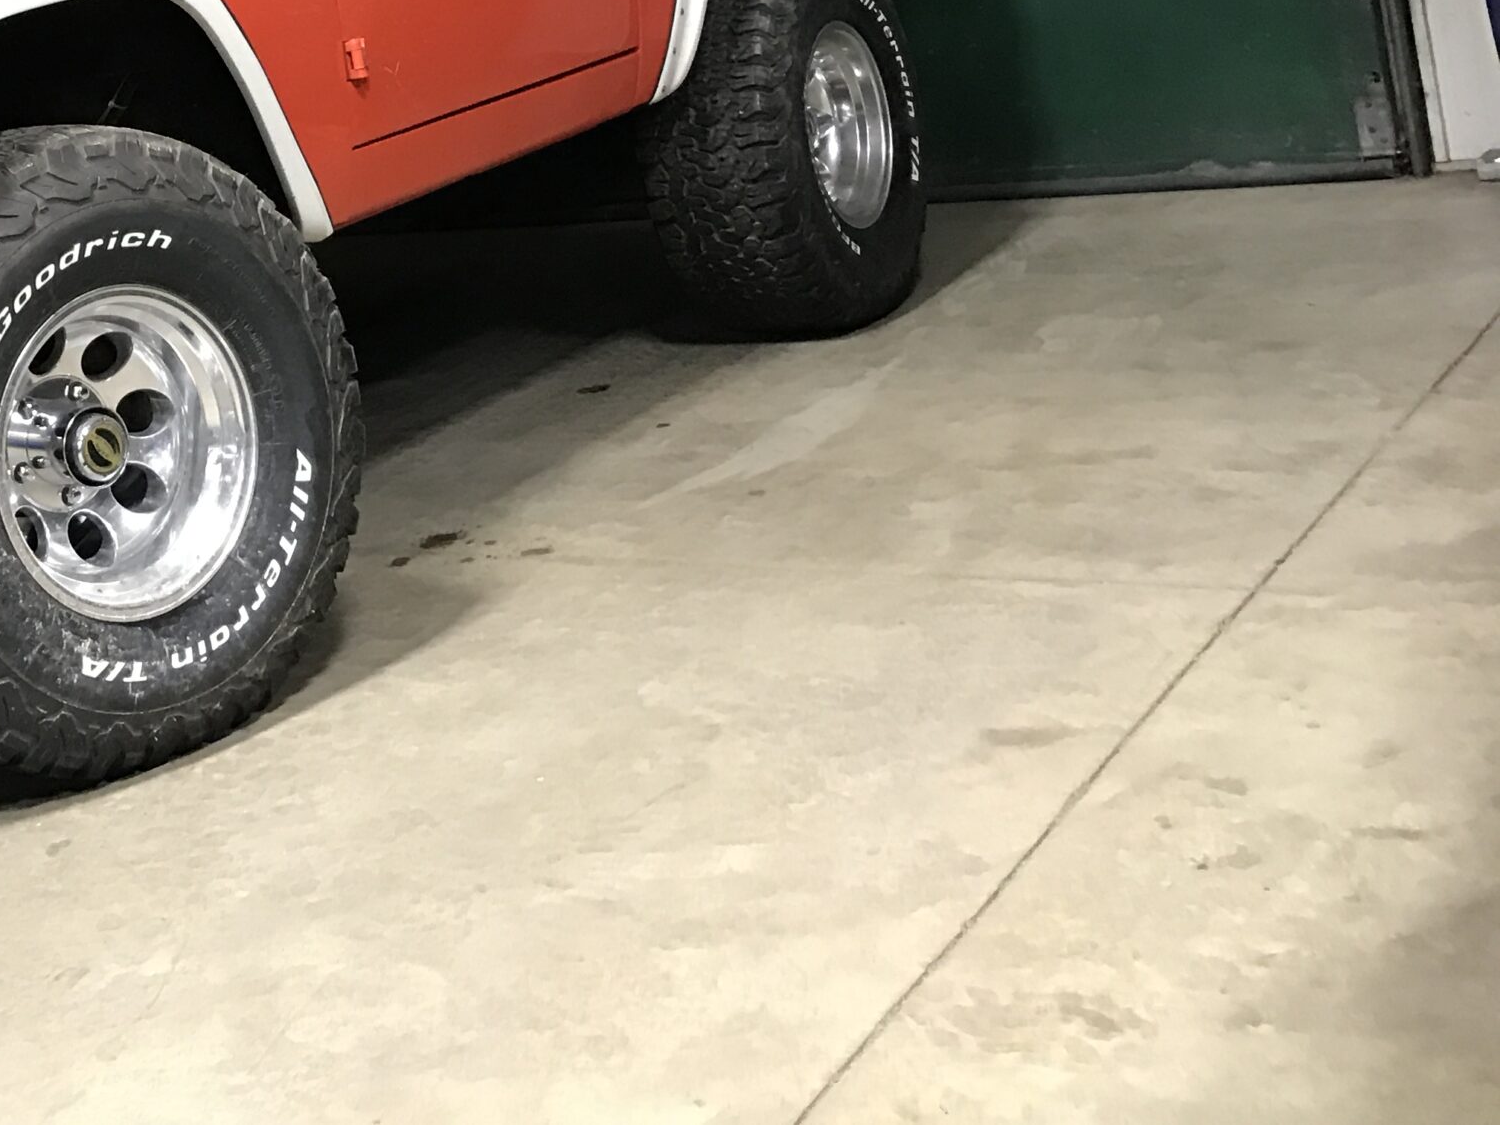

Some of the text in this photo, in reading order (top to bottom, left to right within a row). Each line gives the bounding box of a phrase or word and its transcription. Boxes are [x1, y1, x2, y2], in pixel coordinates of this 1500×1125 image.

[910, 134, 920, 183] T/A
[81, 448, 312, 683] All-Terrain T/A
